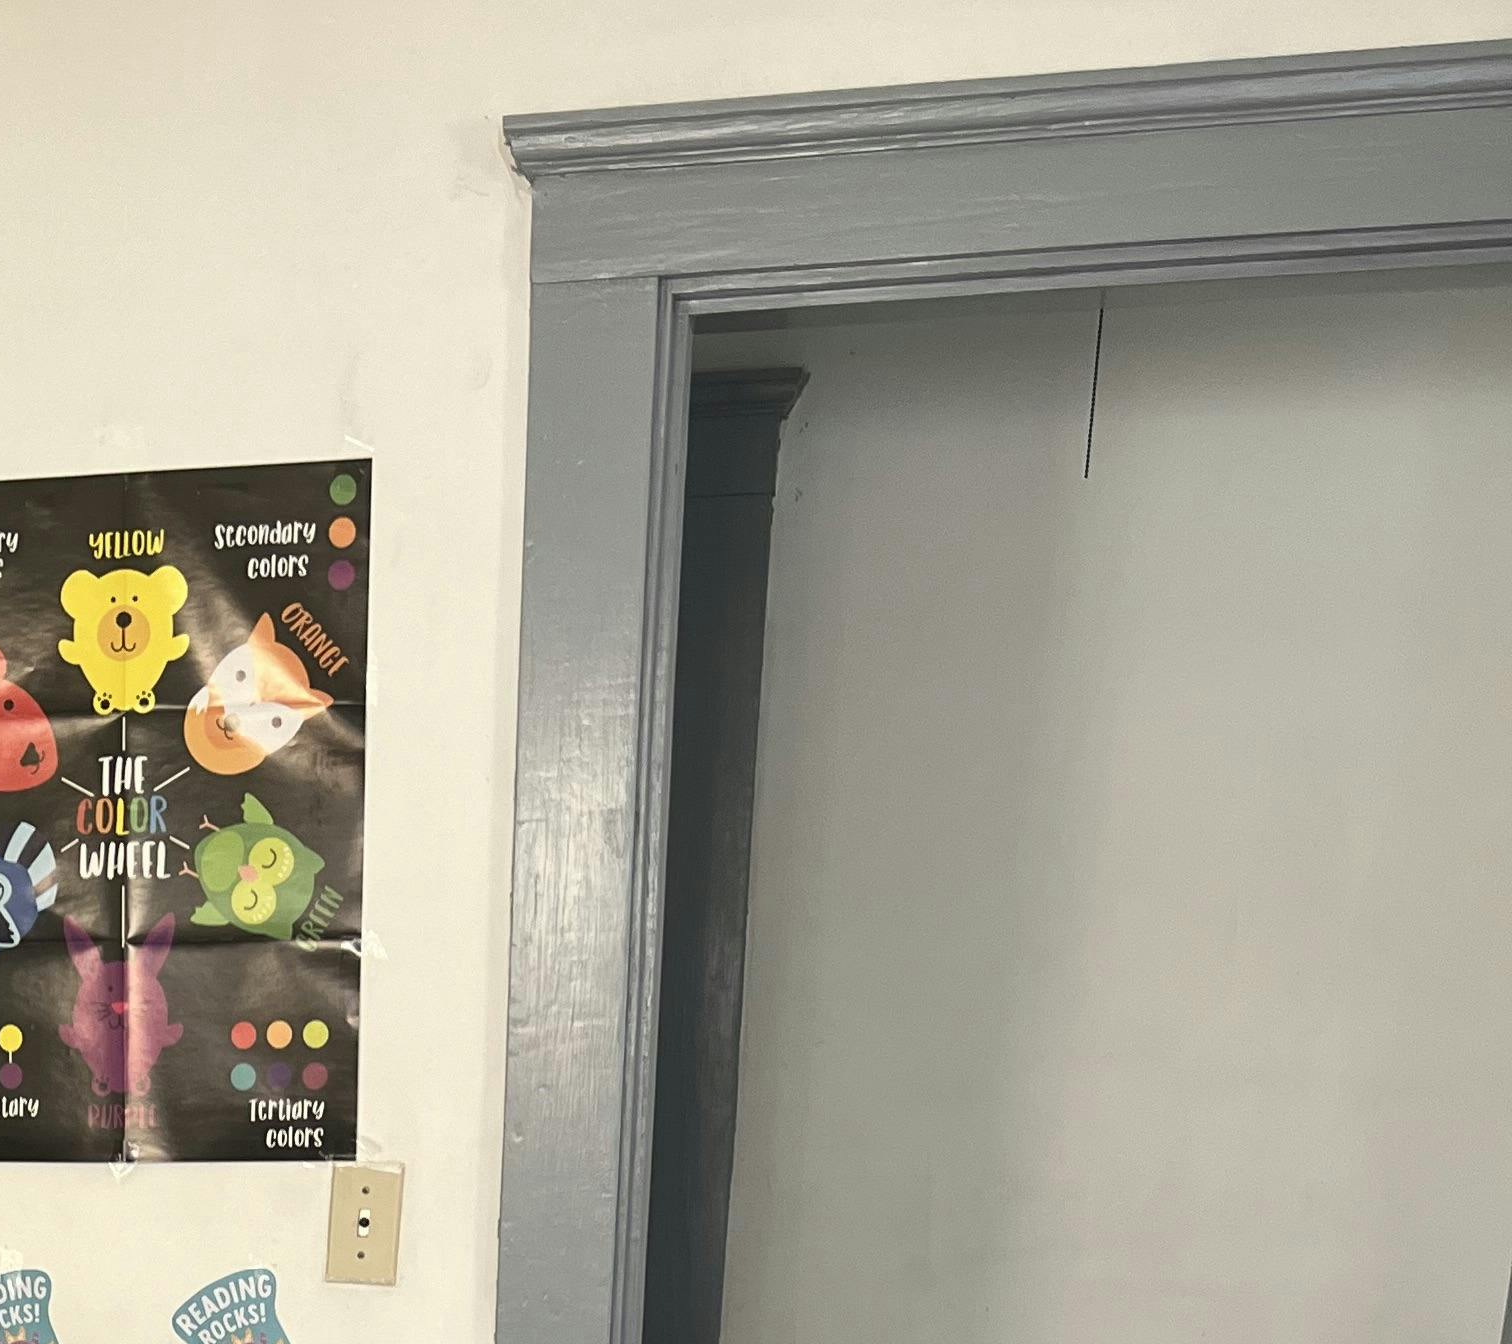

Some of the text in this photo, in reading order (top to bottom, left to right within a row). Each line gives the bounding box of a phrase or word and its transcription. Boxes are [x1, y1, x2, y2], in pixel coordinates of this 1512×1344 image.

[88, 529, 164, 559] YELLOW
[214, 521, 315, 549] Secondary
[247, 554, 308, 579] colors
[281, 602, 350, 677] ORANGE
[98, 756, 148, 794] THE
[76, 795, 167, 835] COLOR
[79, 841, 170, 879] WHEEL
[295, 885, 344, 952] GREEN
[88, 1104, 158, 1129] PURPLE
[248, 1098, 324, 1121] Tertiary
[265, 1126, 324, 1149] colors
[176, 1274, 272, 1335] READING
